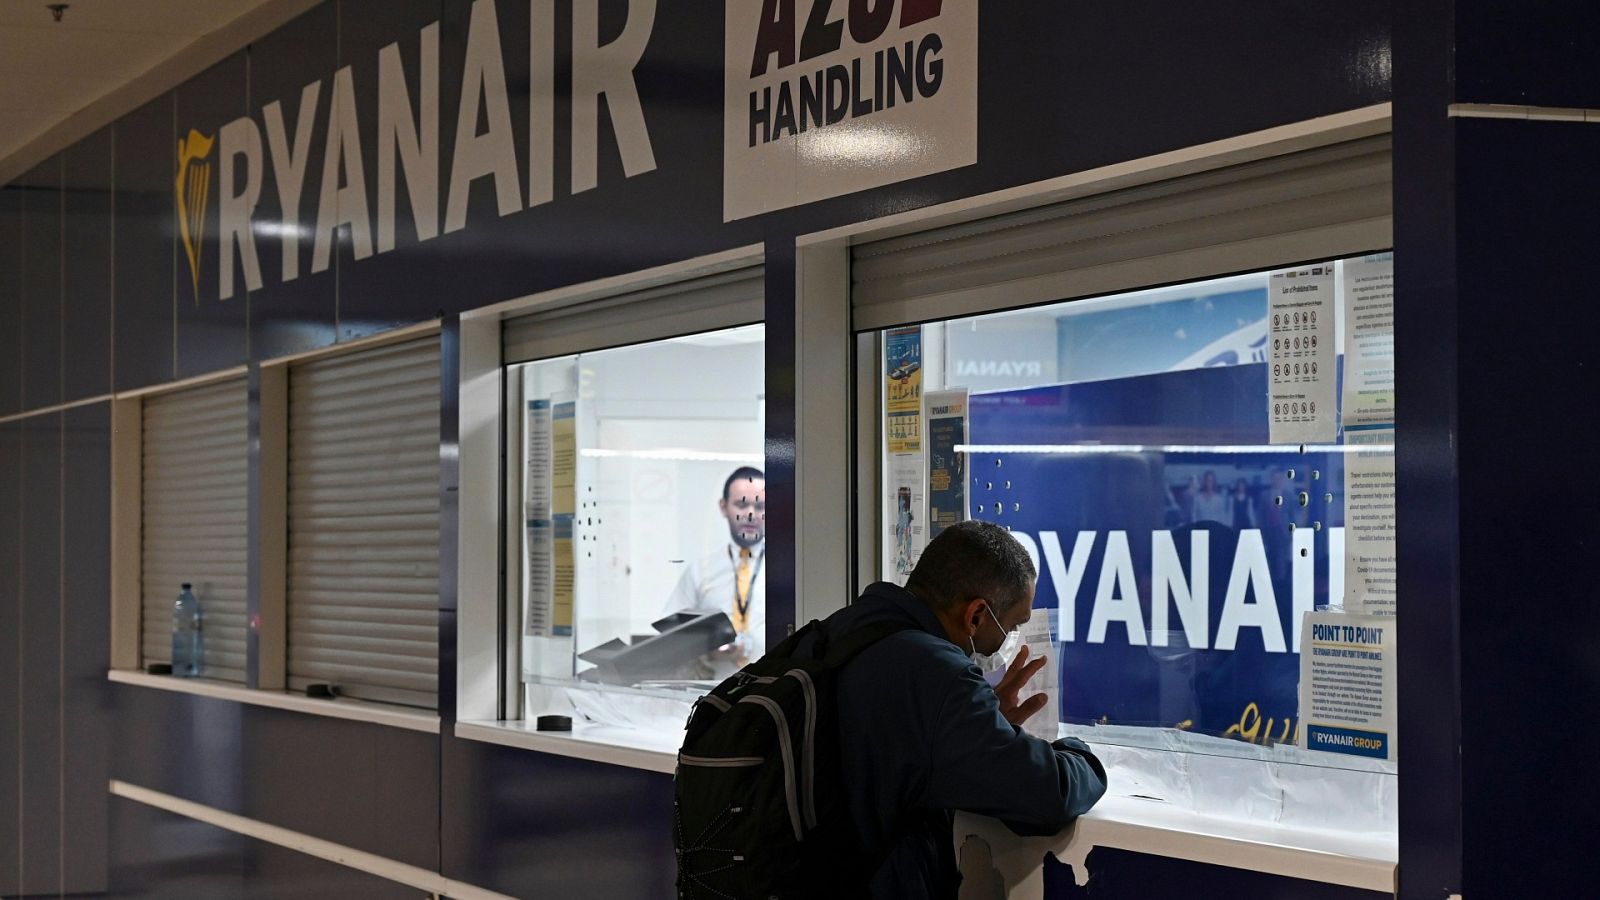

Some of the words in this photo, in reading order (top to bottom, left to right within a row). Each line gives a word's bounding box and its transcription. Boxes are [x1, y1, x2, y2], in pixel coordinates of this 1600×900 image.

[750, 0, 943, 79] AZ
[749, 33, 944, 148] HANDLING
[219, 0, 657, 300] RYANAIR
[1008, 528, 1345, 654] YANAI
[1312, 624, 1341, 642] POINT
[1342, 626, 1353, 643] TO
[1355, 627, 1383, 645] POINT
[1317, 732, 1353, 747] RYANAIR
[1354, 737, 1382, 750] GROUP
